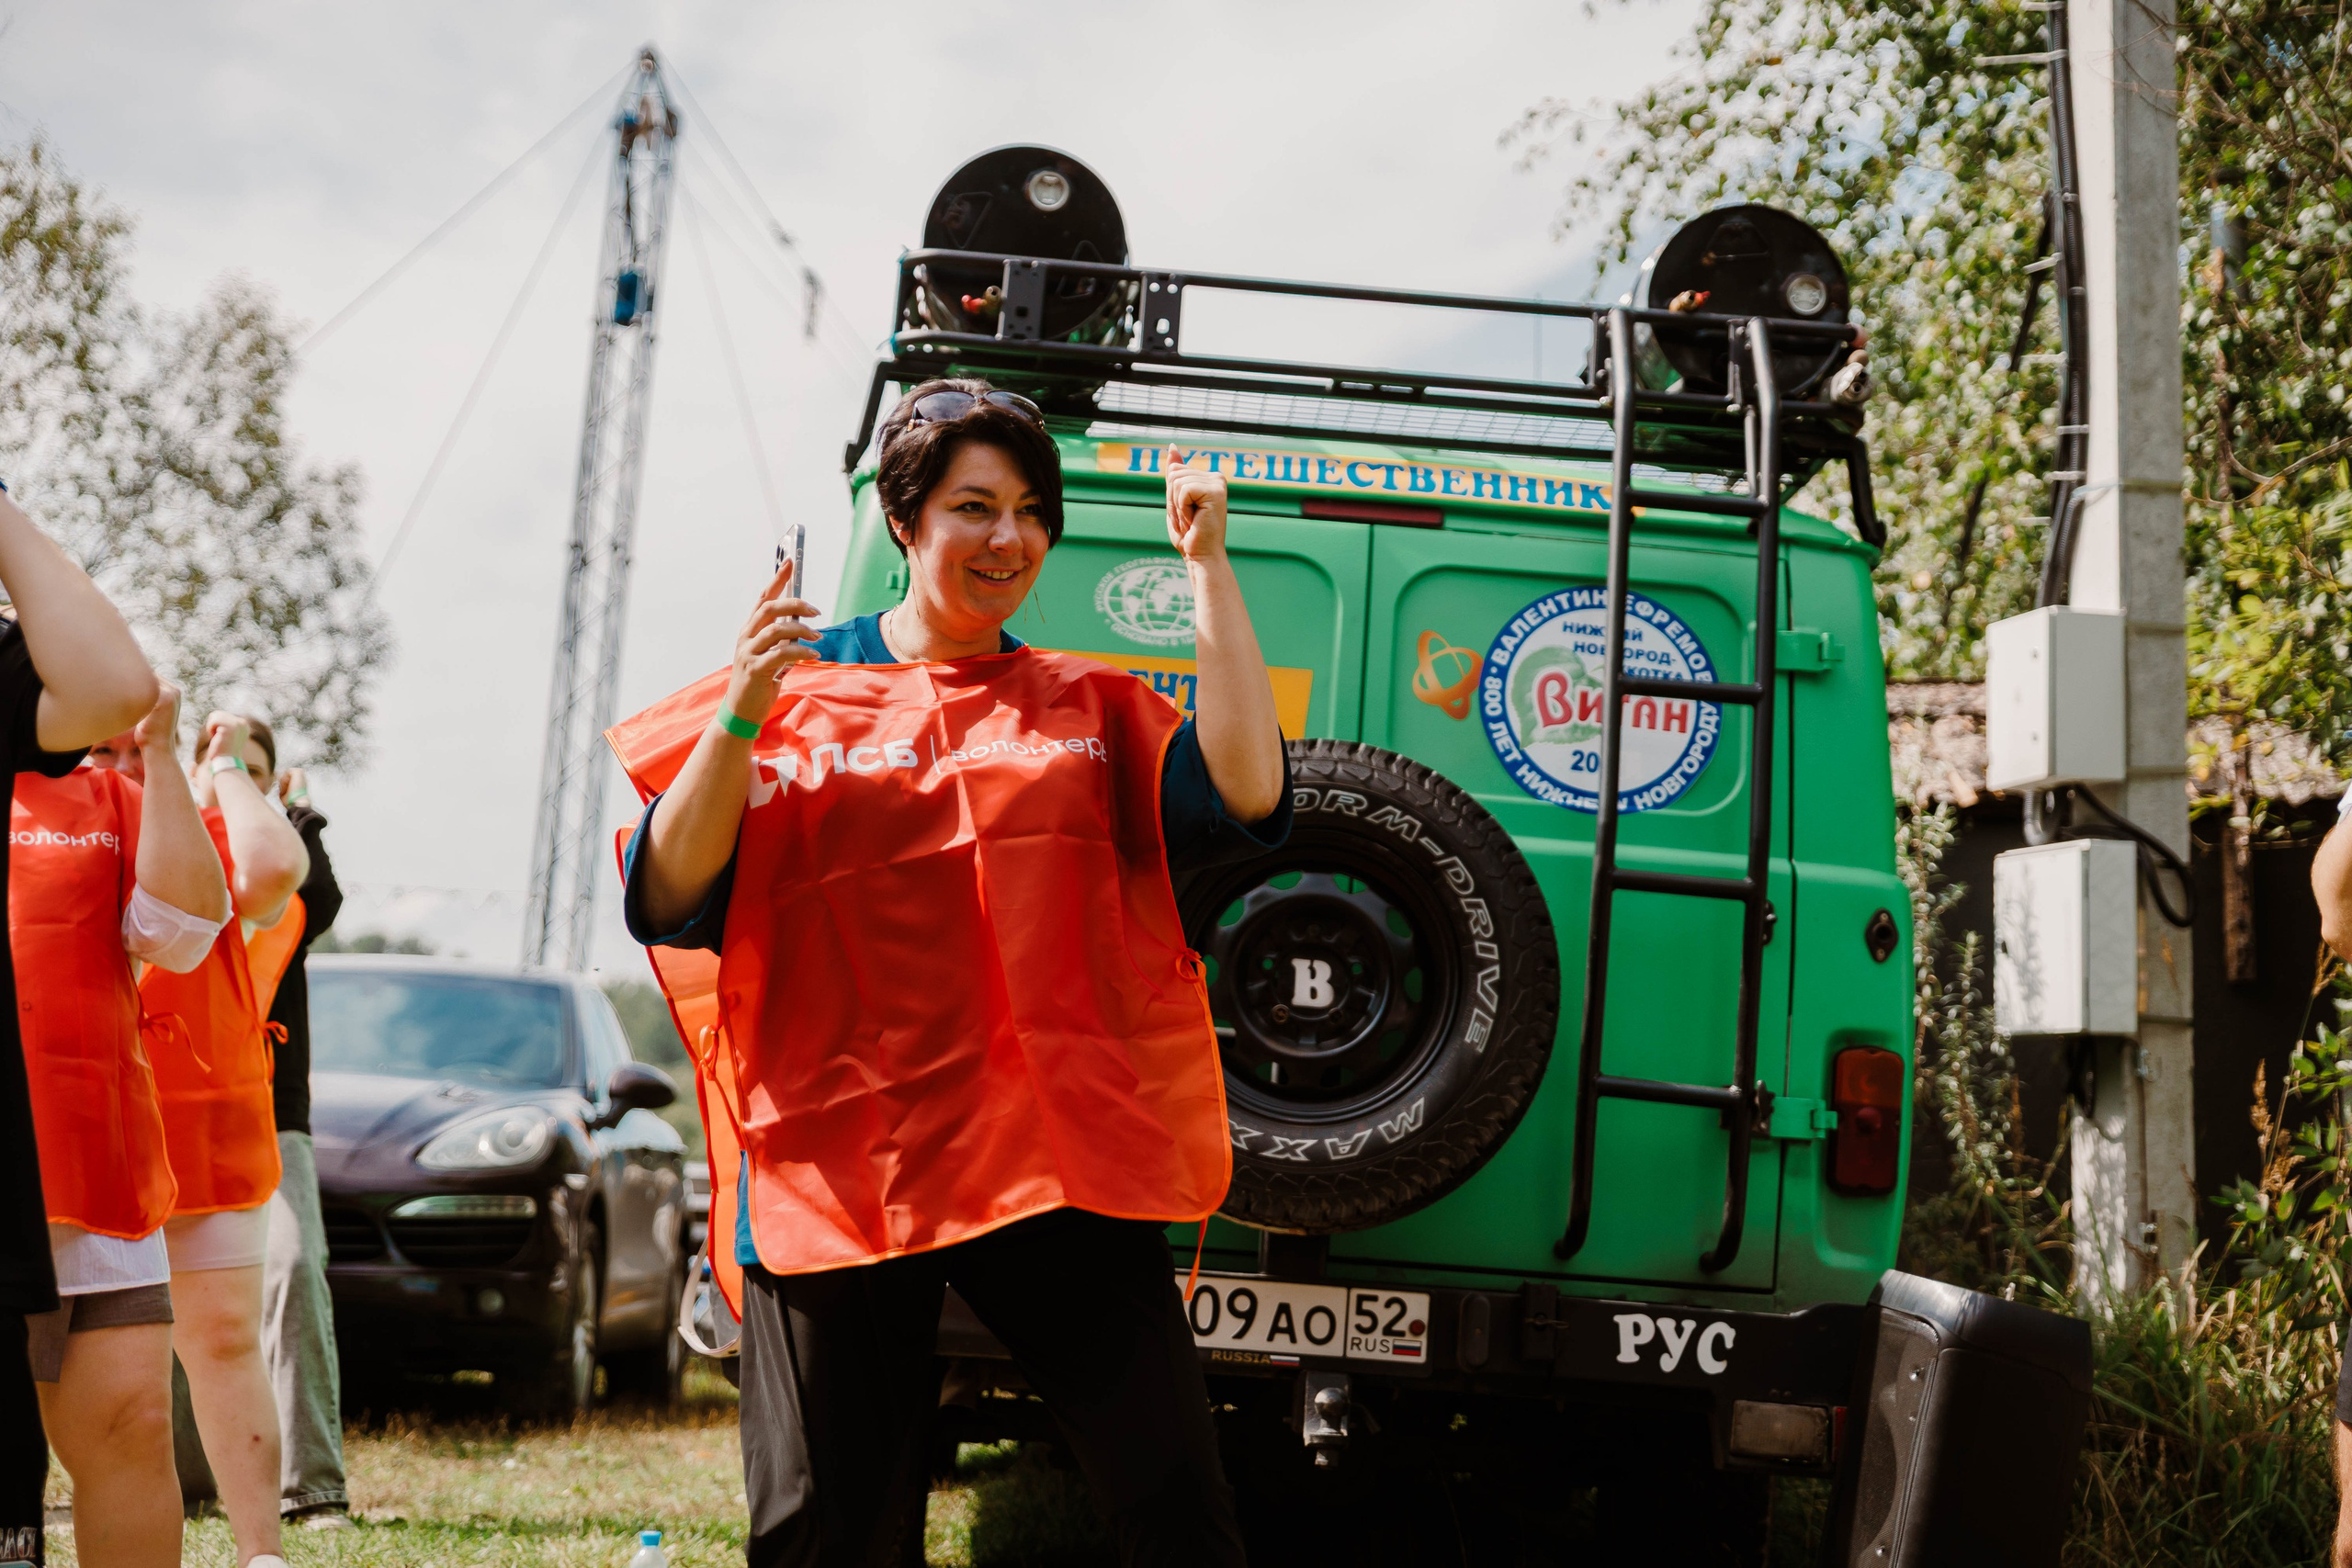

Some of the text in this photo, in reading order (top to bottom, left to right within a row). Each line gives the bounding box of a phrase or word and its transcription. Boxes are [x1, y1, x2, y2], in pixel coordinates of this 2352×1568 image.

[1491, 589, 1609, 667] ВАЛЕНТИН
[1563, 621, 1643, 642] НИЖИЙ
[1484, 676, 1503, 717] 800
[809, 738, 919, 784] ПСБ
[1489, 720, 1522, 763] ЛЕТ
[1294, 787, 1500, 1054] ORM-DRIVE
[1354, 1293, 1408, 1337] 52
[1211, 1350, 1272, 1365] RUSSIA
[1350, 1337, 1391, 1353] RUS
[1612, 1313, 1736, 1375] РУС
